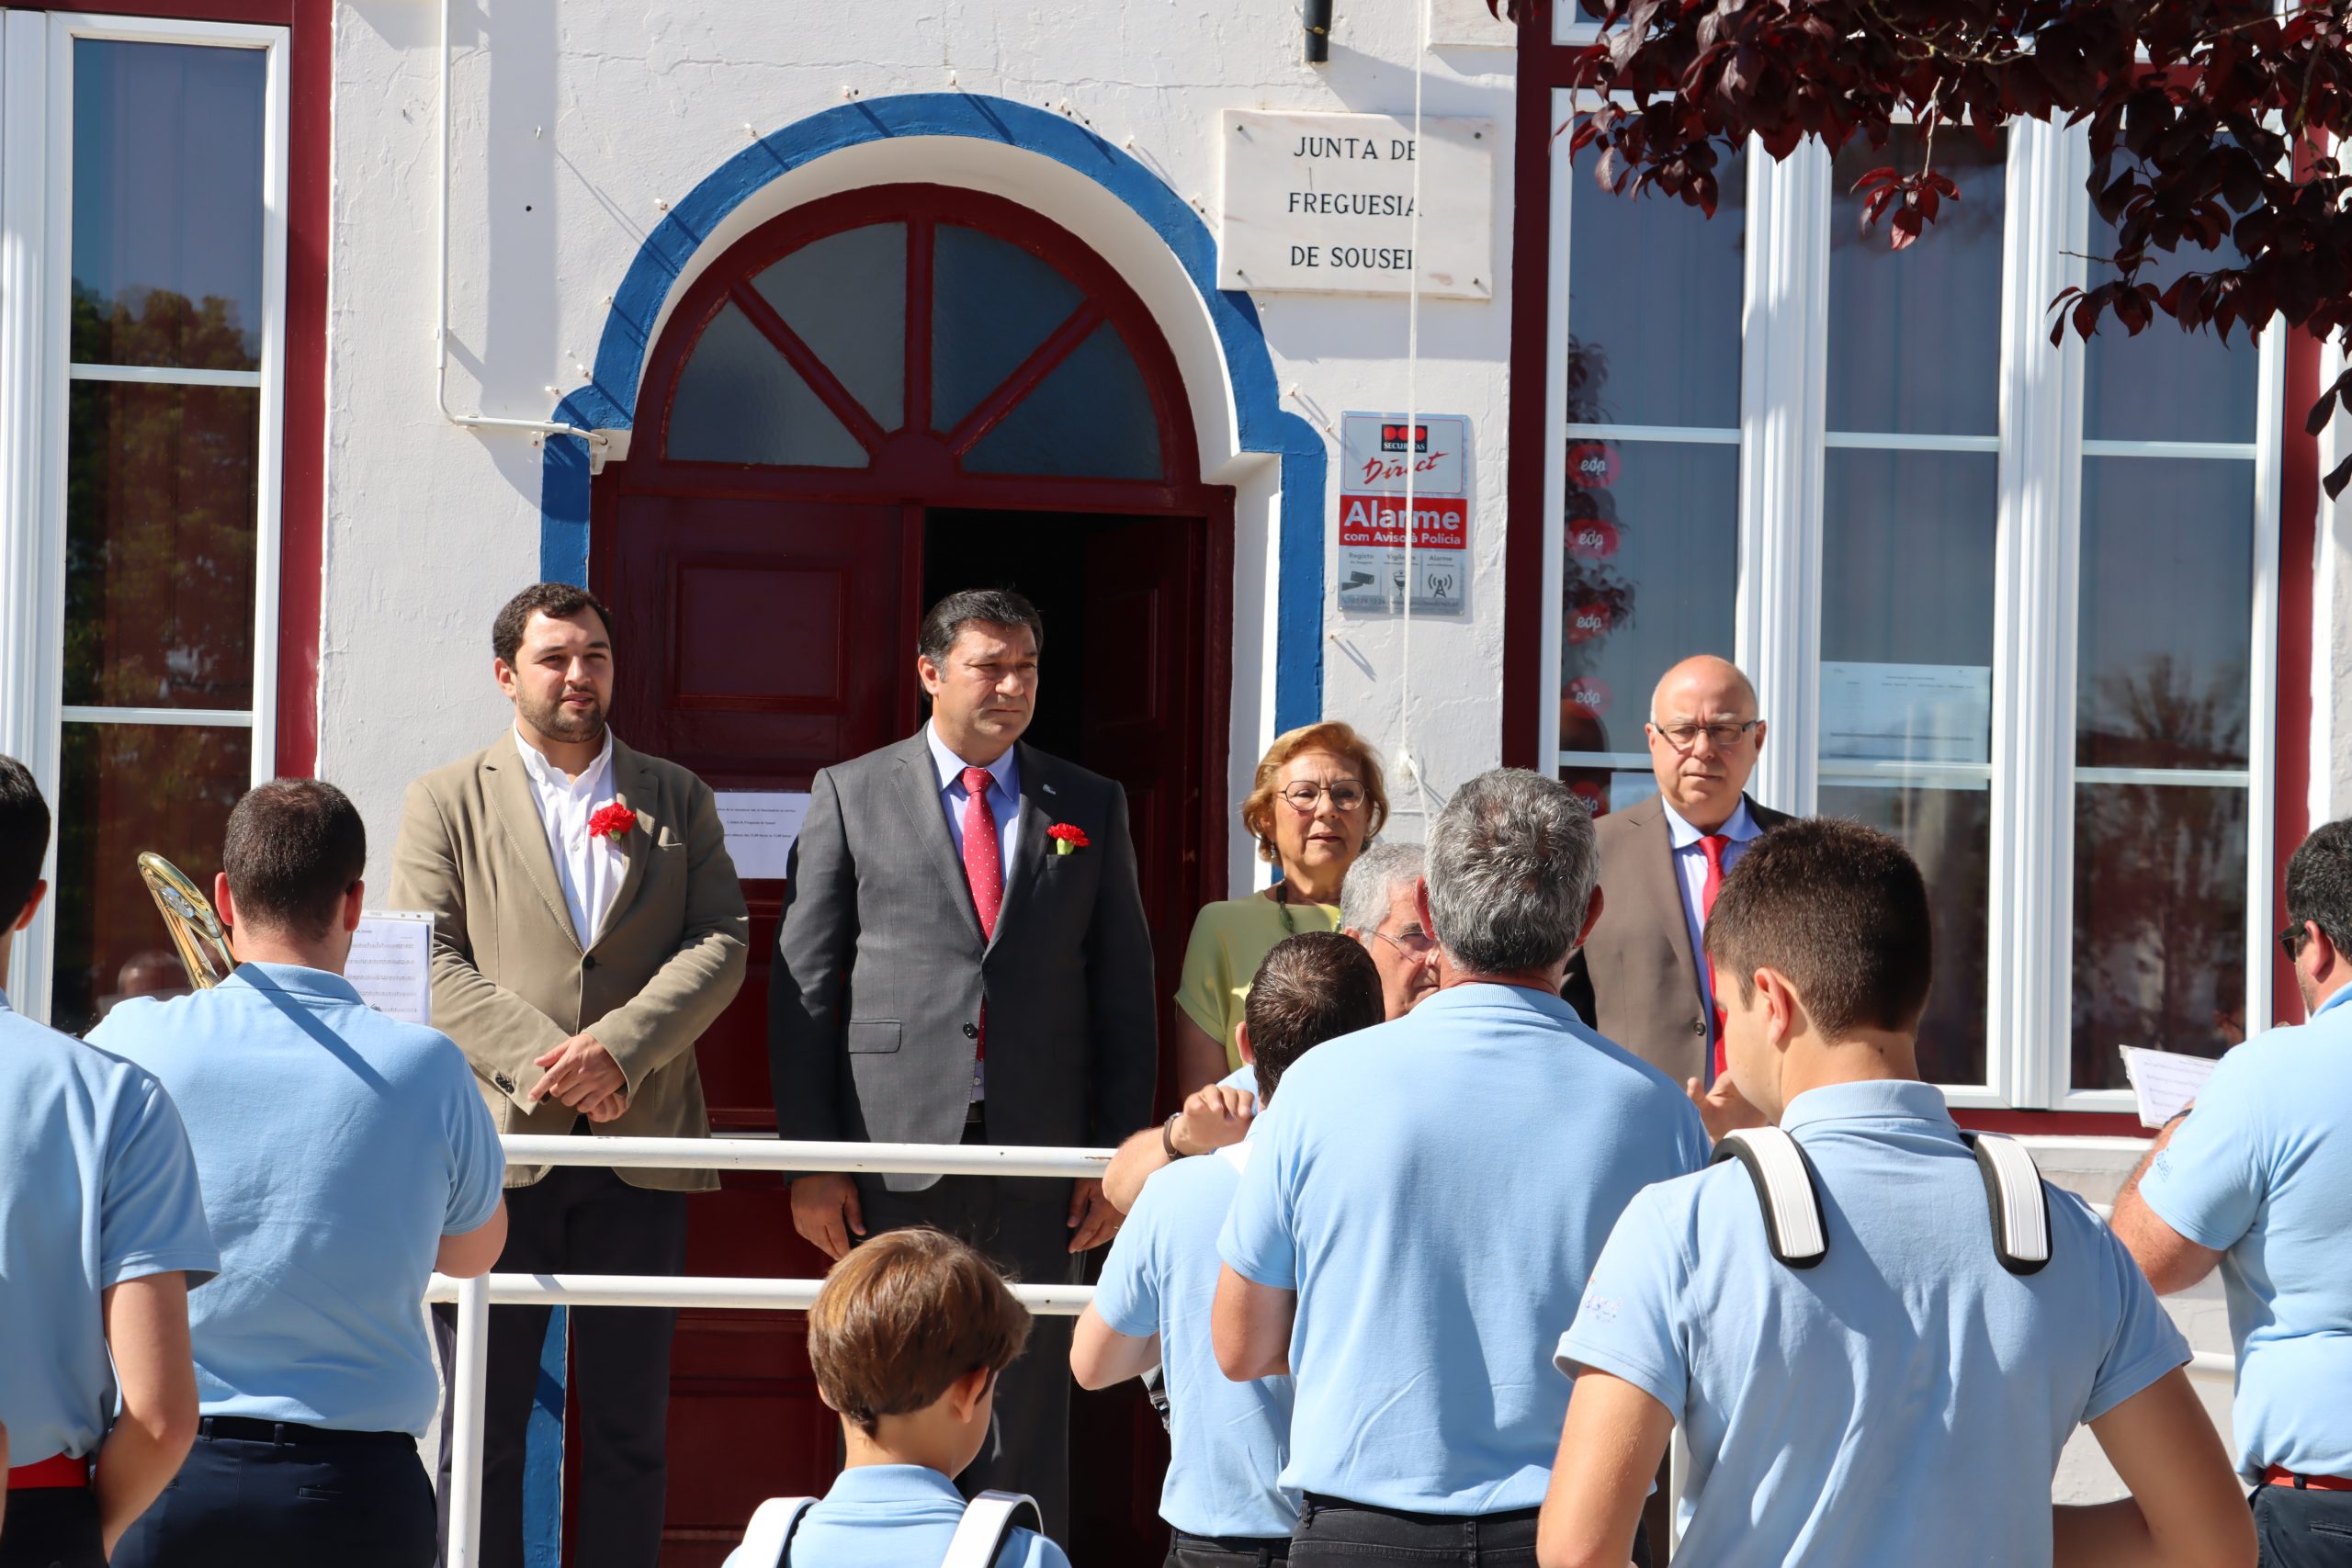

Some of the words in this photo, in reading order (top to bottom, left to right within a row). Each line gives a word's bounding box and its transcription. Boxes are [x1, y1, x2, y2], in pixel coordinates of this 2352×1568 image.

[1294, 137, 1378, 160] JUNTA
[1391, 140, 1416, 161] DE
[1288, 192, 1422, 217] FREGUESIA
[1291, 245, 1319, 266] DE
[1362, 451, 1450, 485] Dirct
[1580, 457, 1606, 475] edp
[1344, 500, 1460, 530] Alarme
[1344, 533, 1369, 541] com
[1374, 531, 1406, 542] Aviso
[1421, 533, 1461, 544] Polícia
[1578, 530, 1603, 548] edp
[1576, 614, 1601, 631] edp
[1575, 689, 1600, 707] edp
[1581, 795, 1598, 815] dp
